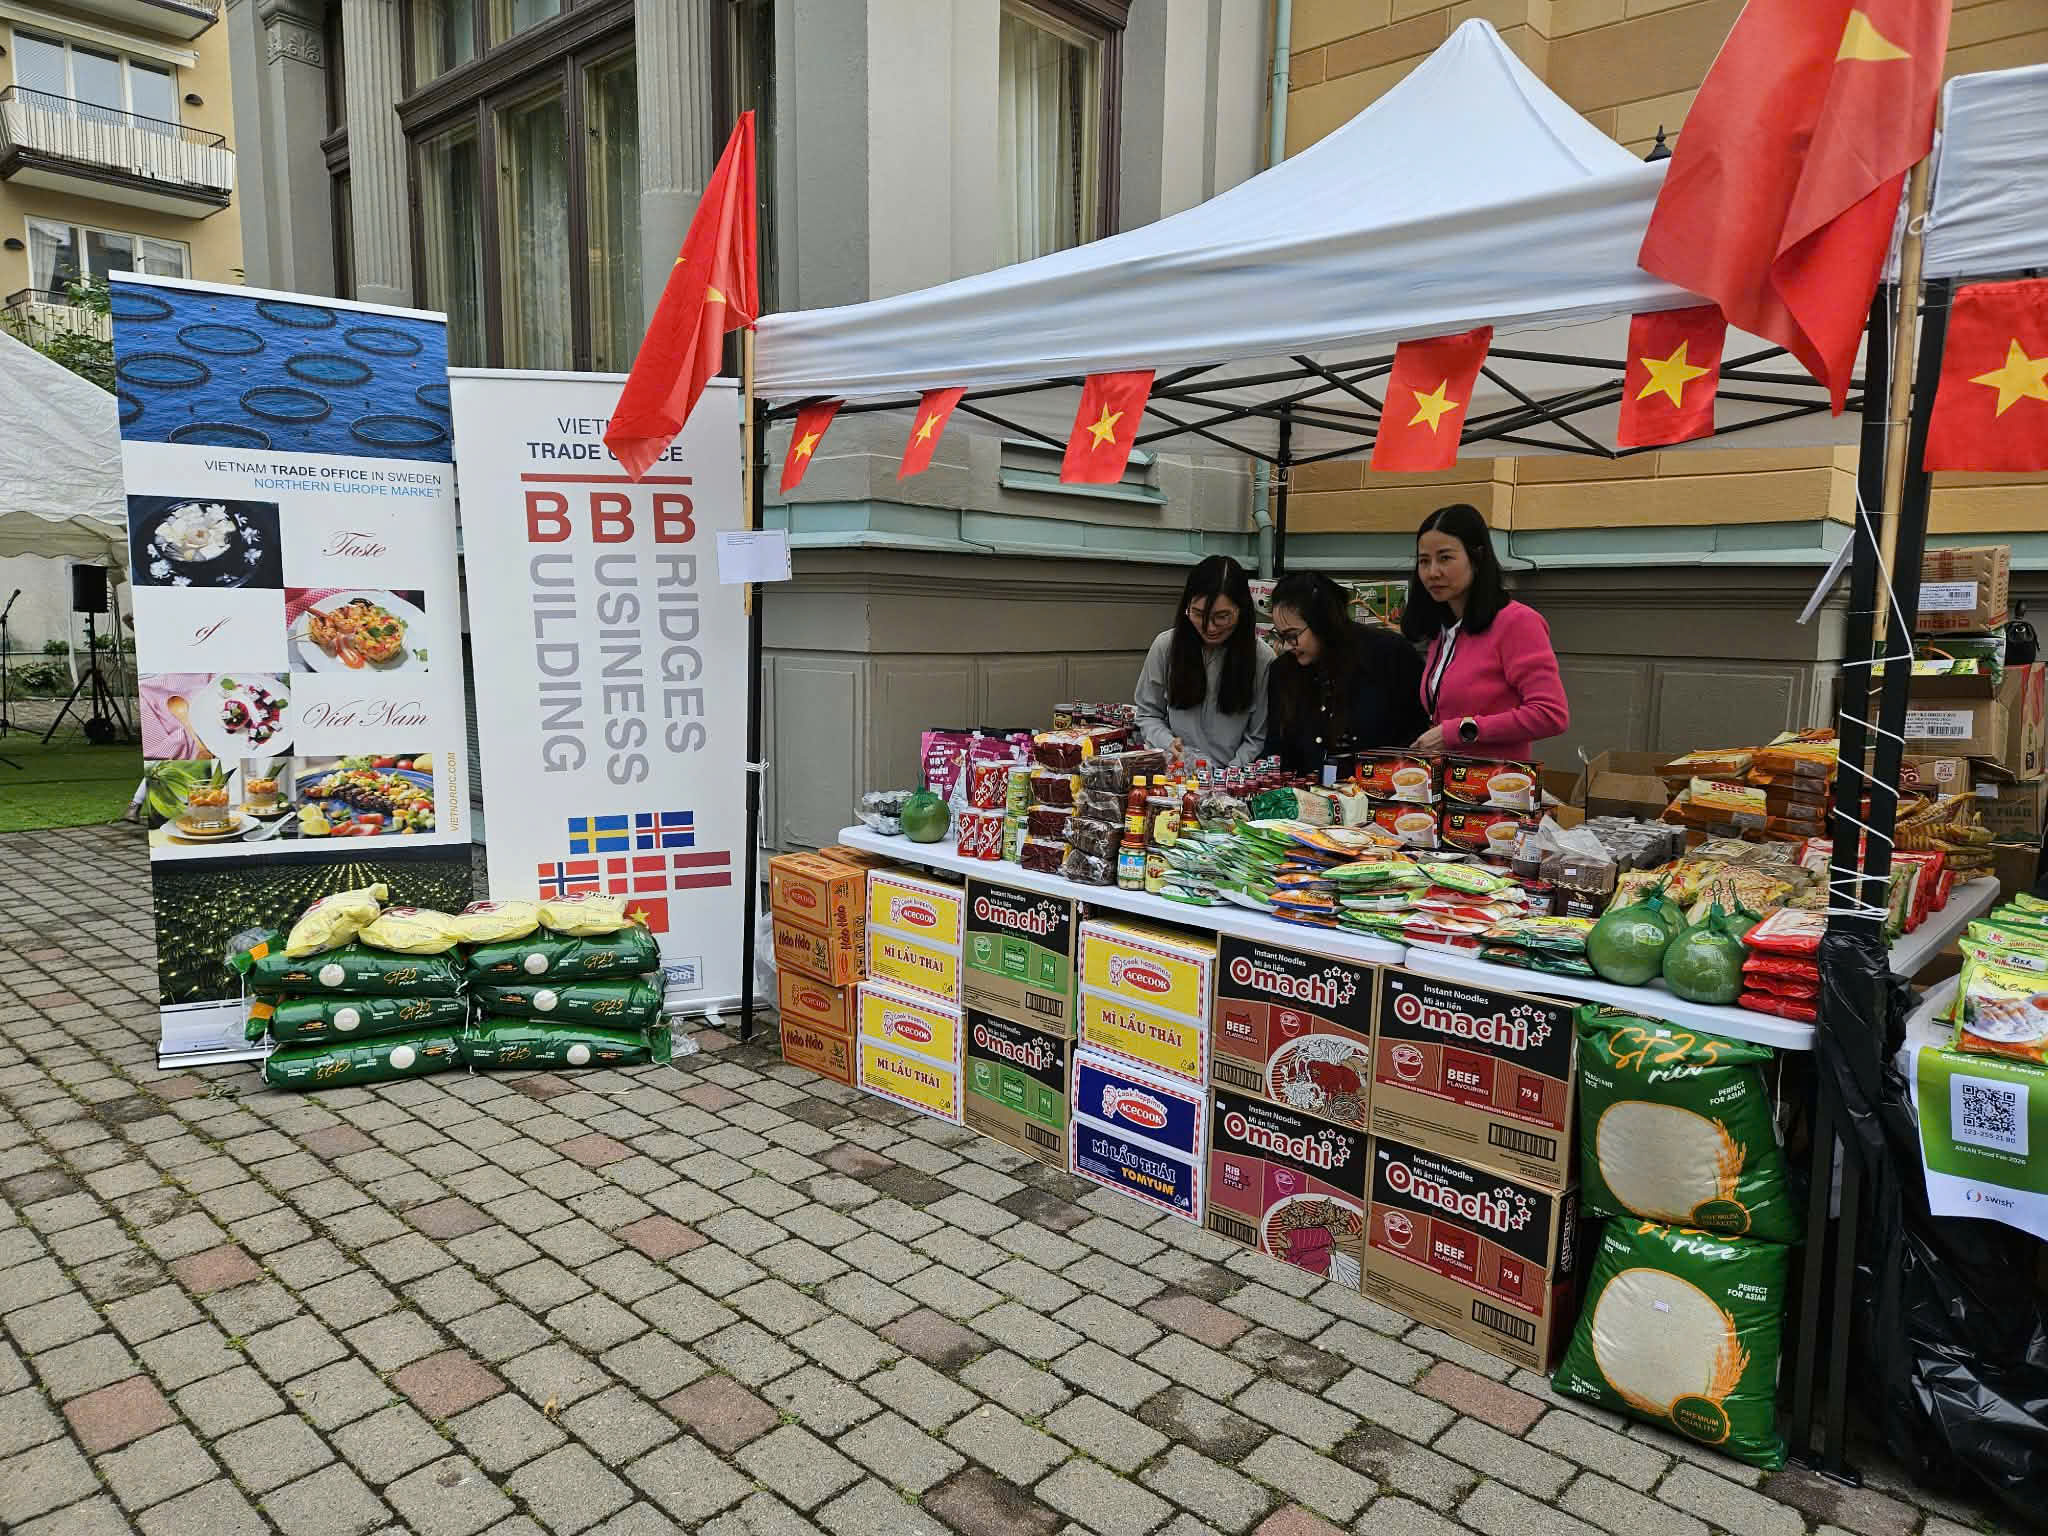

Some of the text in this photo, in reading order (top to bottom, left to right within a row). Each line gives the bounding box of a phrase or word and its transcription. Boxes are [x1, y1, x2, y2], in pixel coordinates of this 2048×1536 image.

[527, 442, 601, 461] TRADE
[205, 460, 441, 484] VIETNAM TRADE OFFICE IN SWEDEN
[254, 478, 442, 499] NORTHERN EUROPE MARKET
[322, 529, 386, 559] Taste
[187, 616, 231, 647] of
[301, 698, 431, 729] Viet Nam
[447, 751, 457, 832] VIETNORDIC.COM
[975, 896, 1047, 936] Omachi
[1254, 949, 1307, 968] Instant Noodles
[1230, 956, 1338, 1008] Omachi
[1423, 984, 1489, 1006] Instant Noodles
[1226, 1020, 1252, 1034] BEEF
[1394, 993, 1529, 1050] Omachi
[974, 1024, 1042, 1071] Omachi
[1447, 1068, 1480, 1086] BEEF
[1520, 1087, 1531, 1099] 79
[1710, 1088, 1746, 1105] FOR ASIAN
[1718, 1081, 1745, 1096] PERFECT
[1248, 1104, 1302, 1127] Instant Noodles
[1224, 1112, 1333, 1171] Omachi
[1225, 1164, 1241, 1176] RIB
[1413, 1154, 1474, 1183] Instant Noodles
[1121, 1167, 1175, 1196] TOMYUM
[1386, 1161, 1510, 1233] Omachi
[1985, 1195, 2012, 1208] swish
[1434, 1240, 1465, 1260] BEEF
[1672, 1236, 1740, 1261] rice
[1503, 1268, 1513, 1281] 79
[1727, 1288, 1768, 1302] FOR ASIAN
[1738, 1283, 1768, 1294] PERFECT
